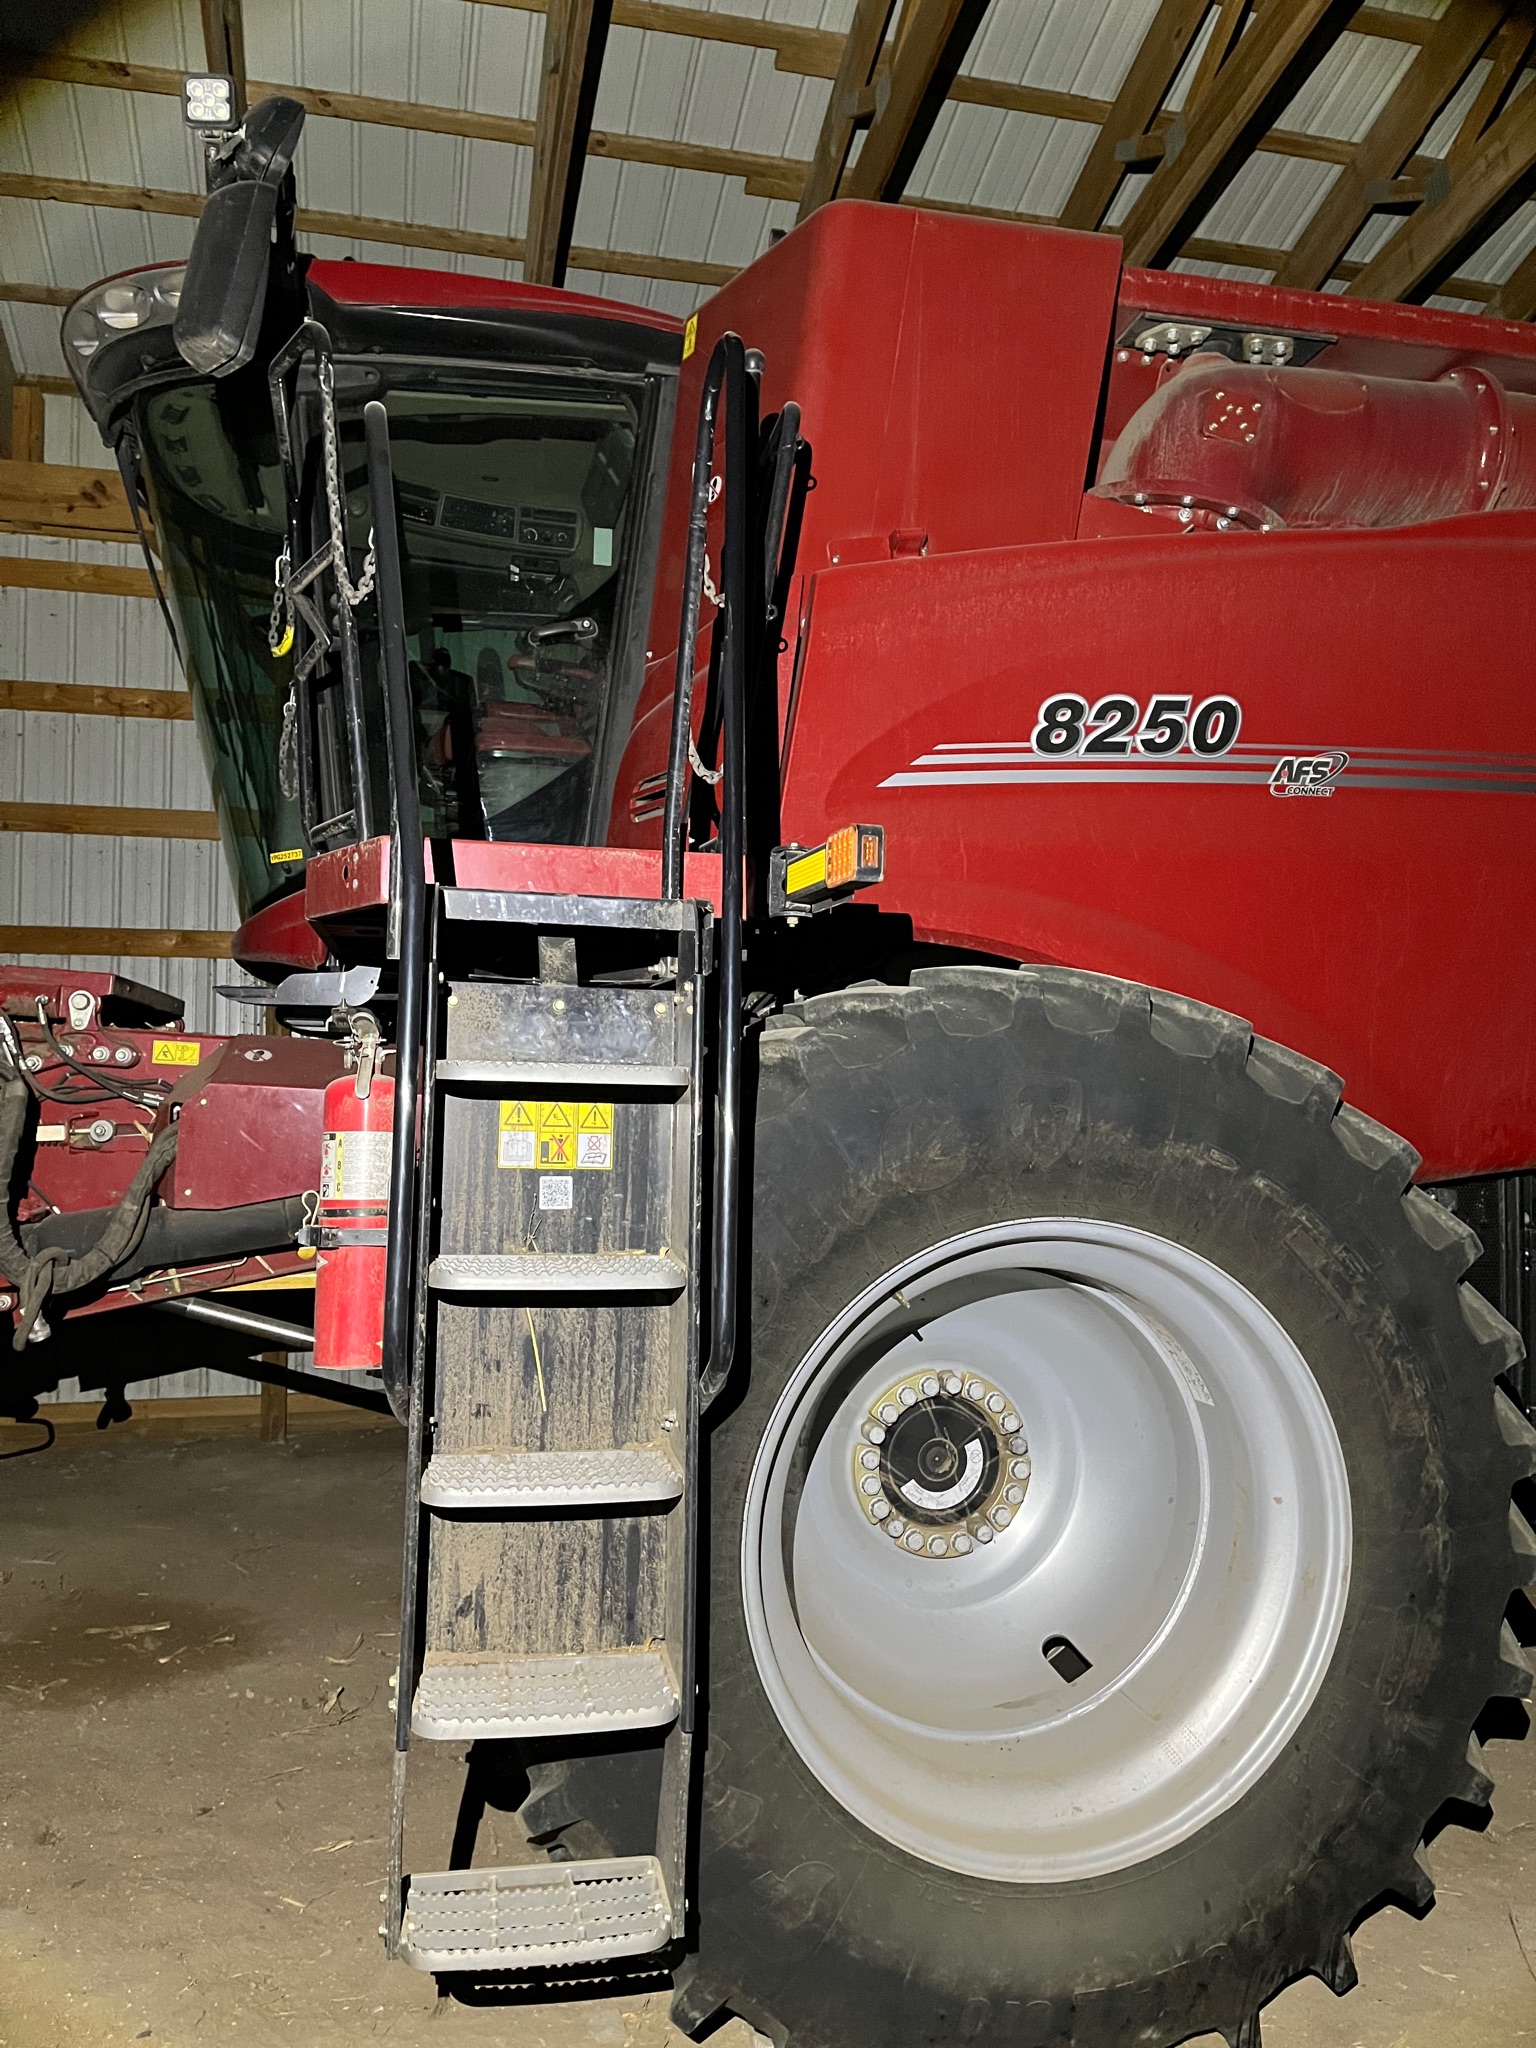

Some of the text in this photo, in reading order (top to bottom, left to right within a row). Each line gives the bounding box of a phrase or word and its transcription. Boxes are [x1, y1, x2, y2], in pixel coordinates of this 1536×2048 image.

[1031, 693, 1242, 758] 8250
[1267, 756, 1333, 786] AFS
[1286, 786, 1335, 797] CONNECT
